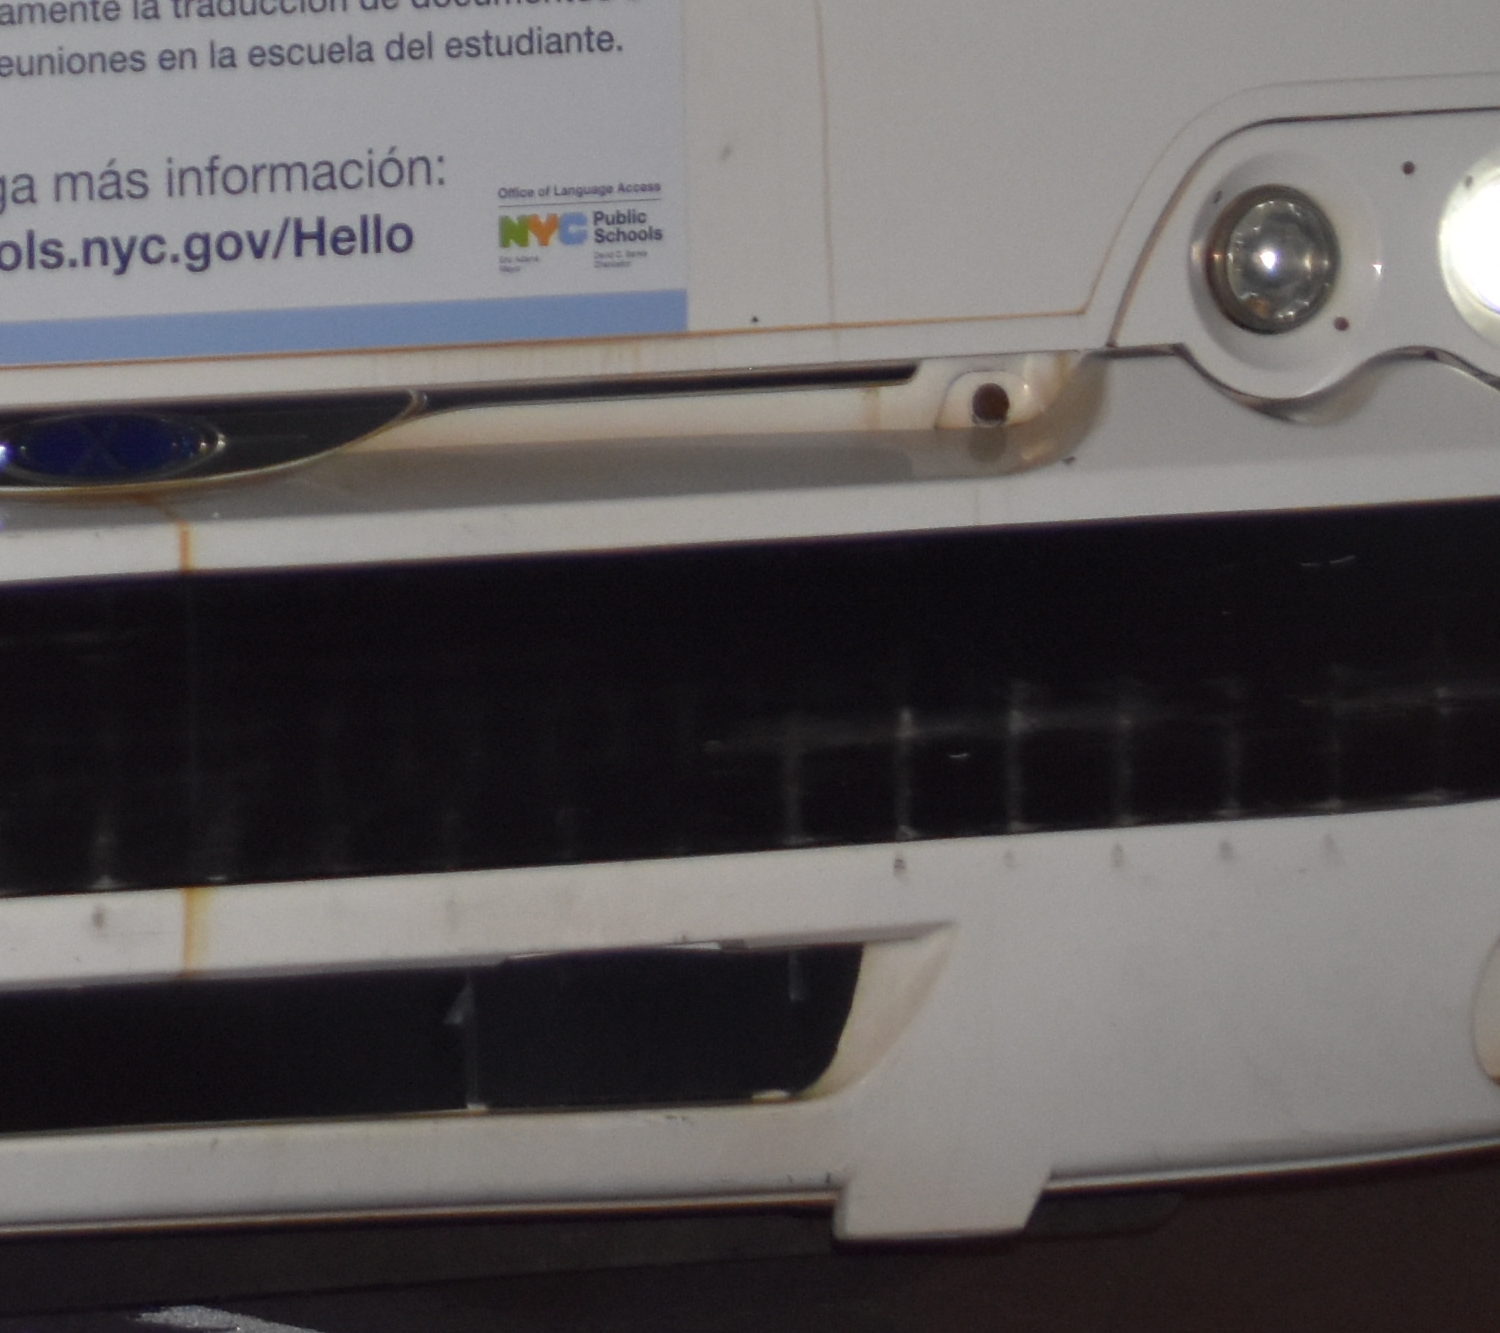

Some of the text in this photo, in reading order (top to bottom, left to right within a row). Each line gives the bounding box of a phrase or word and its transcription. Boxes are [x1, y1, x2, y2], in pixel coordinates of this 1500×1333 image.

[158, 46, 198, 71] en
[209, 40, 237, 69] la
[248, 35, 374, 66] escuela
[385, 32, 433, 62] del
[445, 26, 623, 59] estudiante.
[53, 159, 149, 203] más
[165, 147, 447, 198] información:
[498, 181, 661, 199] Office of Language Access
[499, 212, 588, 248] NYC
[593, 208, 647, 226] Public
[594, 225, 663, 244] Schools
